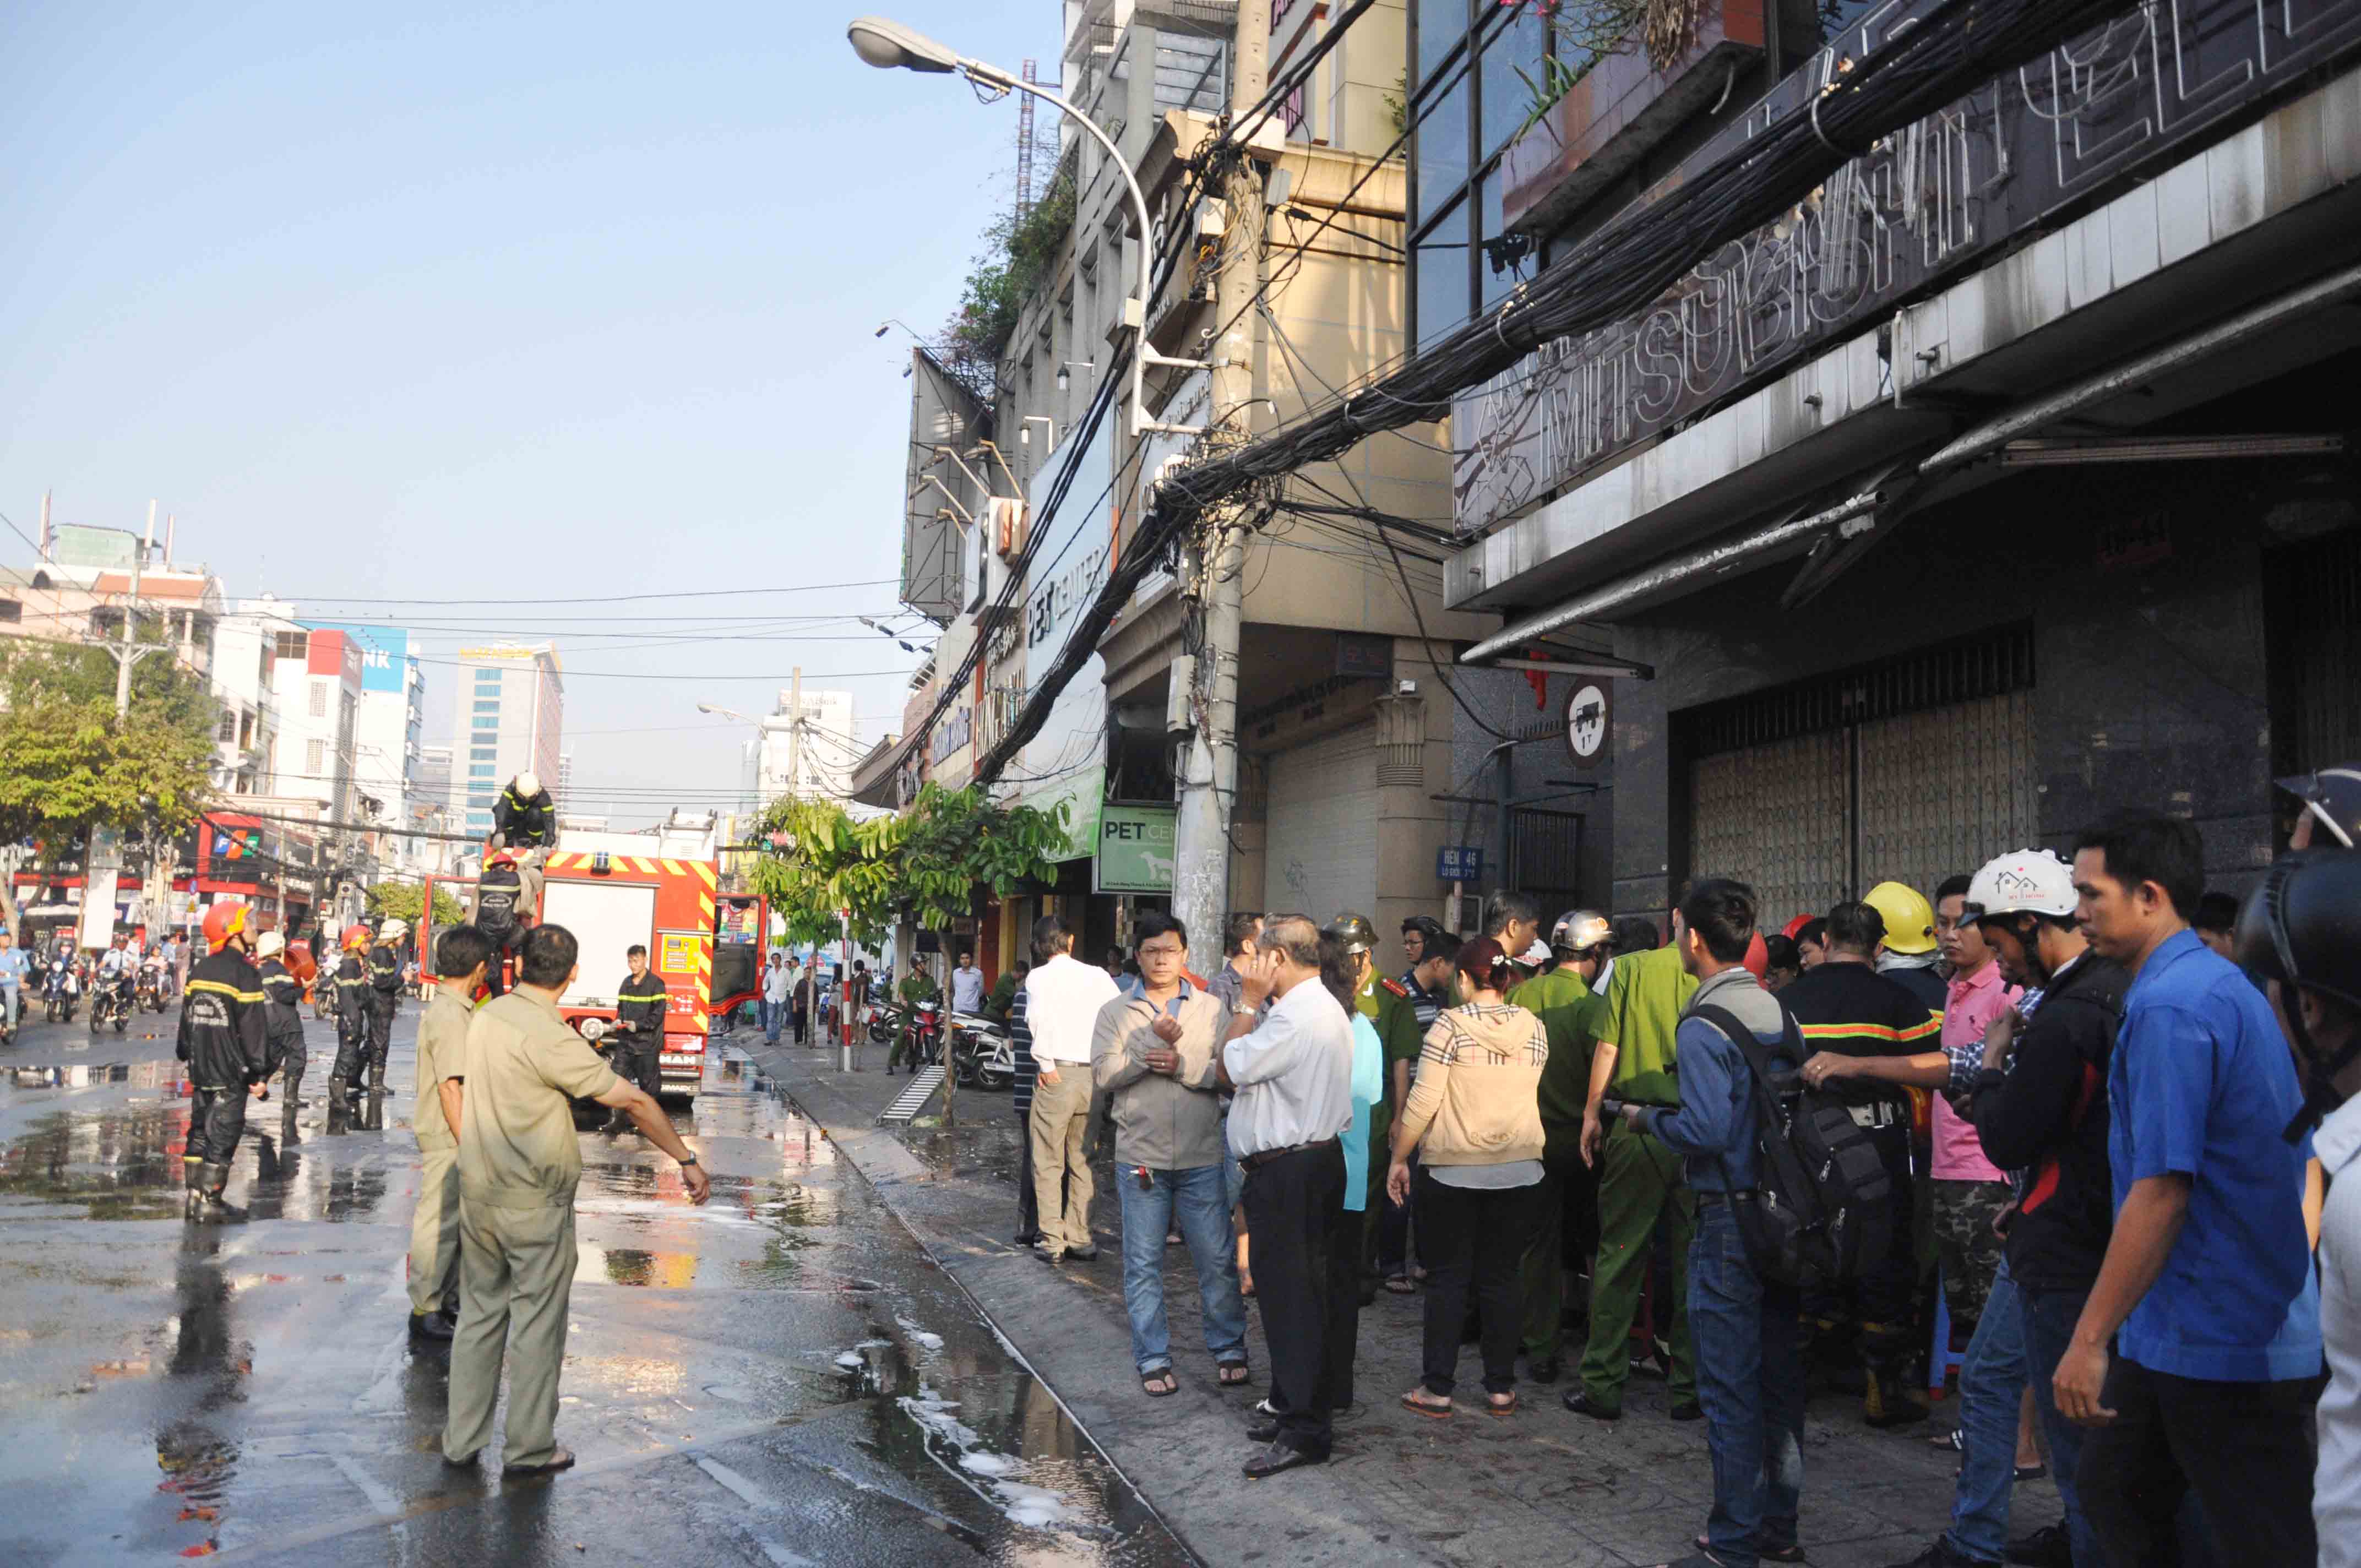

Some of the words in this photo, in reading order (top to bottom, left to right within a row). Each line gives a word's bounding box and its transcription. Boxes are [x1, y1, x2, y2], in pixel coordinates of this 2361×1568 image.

[1105, 821, 1146, 840] PET
[1466, 851, 1476, 867] 46
[659, 1055, 696, 1064] MAN
